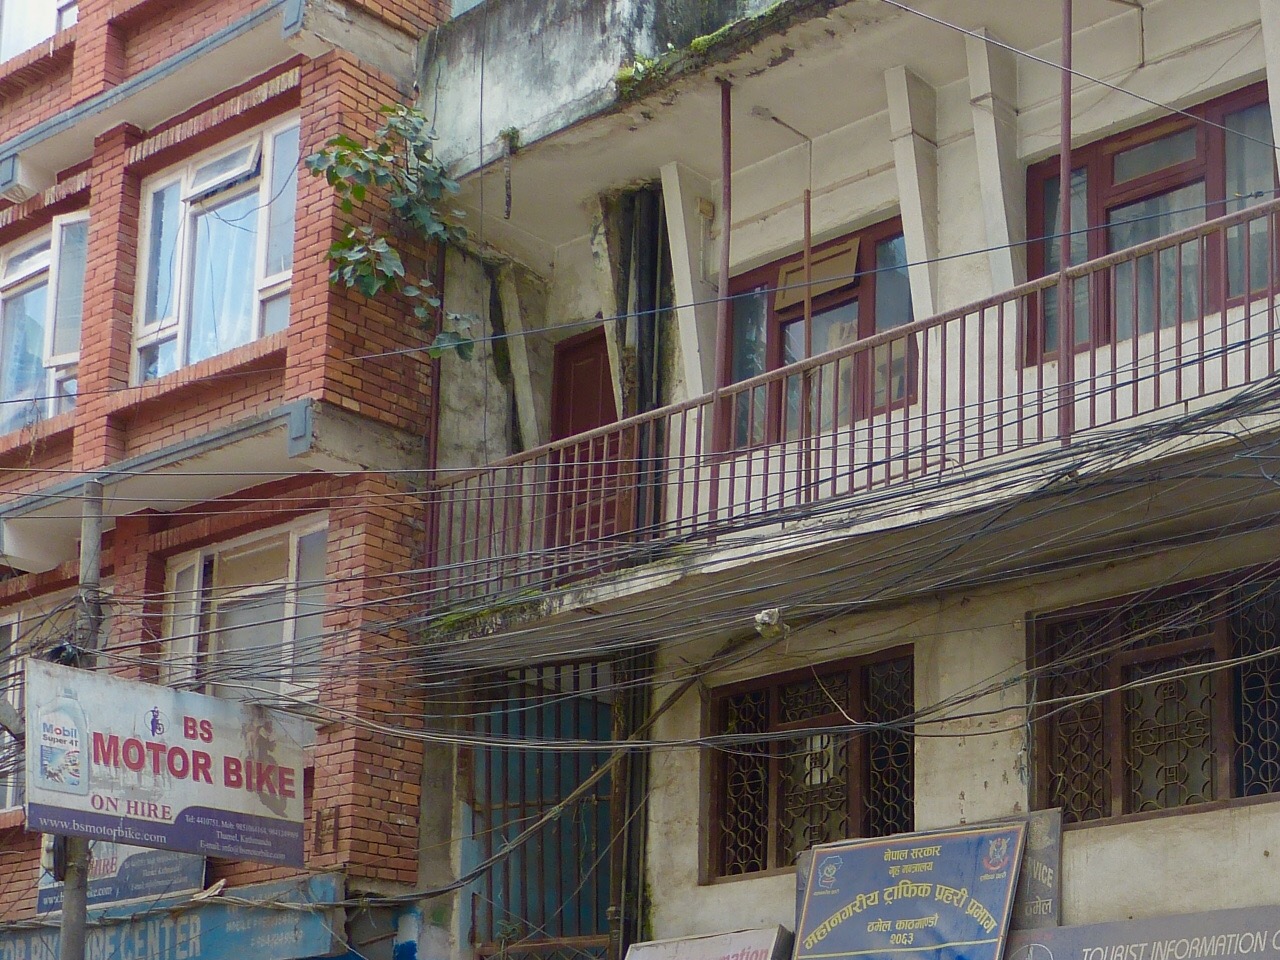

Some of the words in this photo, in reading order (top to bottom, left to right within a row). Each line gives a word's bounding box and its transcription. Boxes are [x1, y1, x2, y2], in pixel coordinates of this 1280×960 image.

[42, 734, 67, 745] Super
[69, 739, 79, 747] 4T
[43, 722, 77, 739] Mobil
[183, 716, 213, 743] BS
[93, 732, 213, 784] MOTOR
[223, 756, 296, 799] BIKE
[91, 794, 118, 812] ON
[127, 800, 173, 820] HIRE
[39, 818, 167, 843] www.bsmotorbike.com
[884, 848, 908, 862] नेपाल
[911, 845, 942, 859] सरकार
[802, 890, 879, 950] महानगरीय
[883, 879, 933, 906] ट्राफिक
[934, 883, 969, 909] प्रहरी
[965, 898, 998, 934] प्रभाग
[890, 932, 914, 945] २०६३
